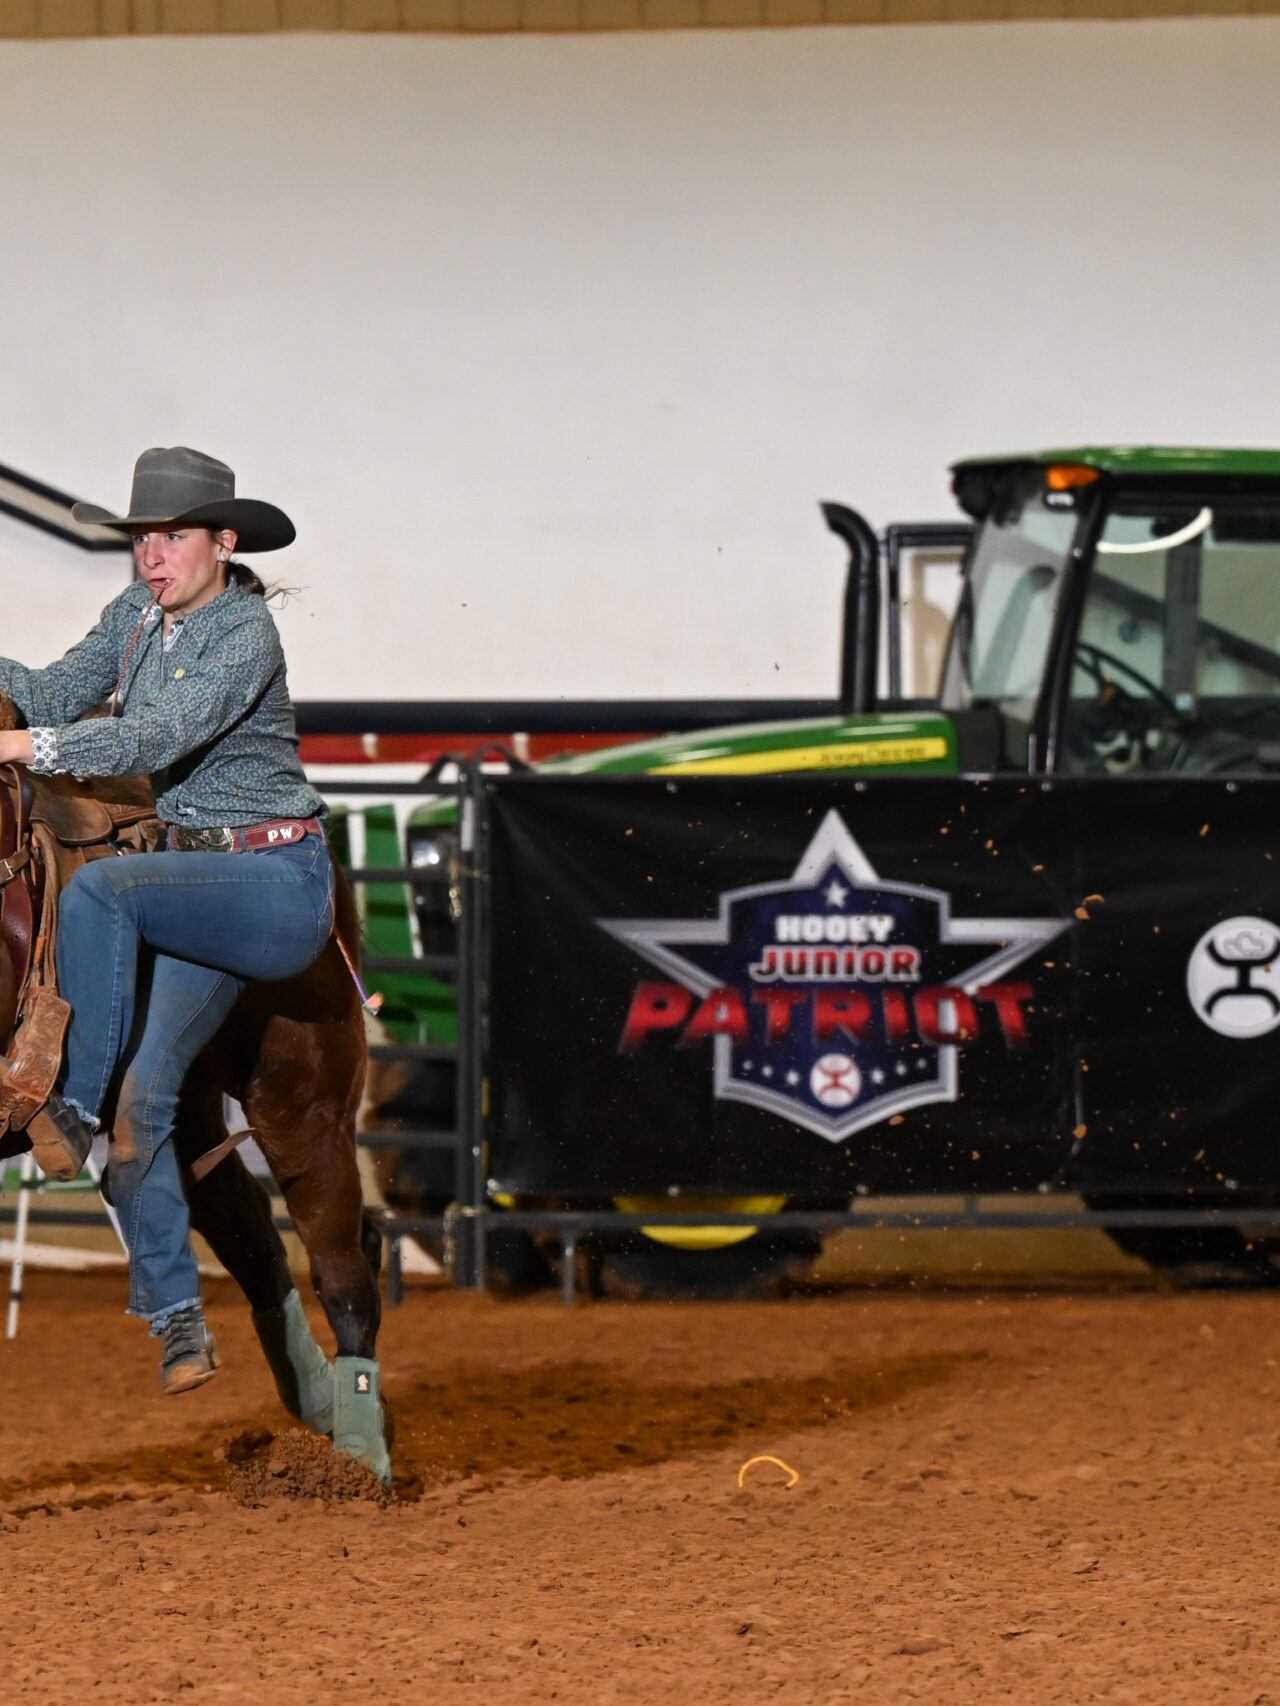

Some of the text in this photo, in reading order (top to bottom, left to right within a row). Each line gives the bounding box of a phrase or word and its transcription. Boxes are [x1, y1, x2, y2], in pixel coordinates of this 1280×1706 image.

[267, 827, 293, 843] PW
[776, 914, 895, 942] HOOEY
[749, 945, 920, 982] JUNIOR
[621, 981, 1035, 1053] PATRIOT
